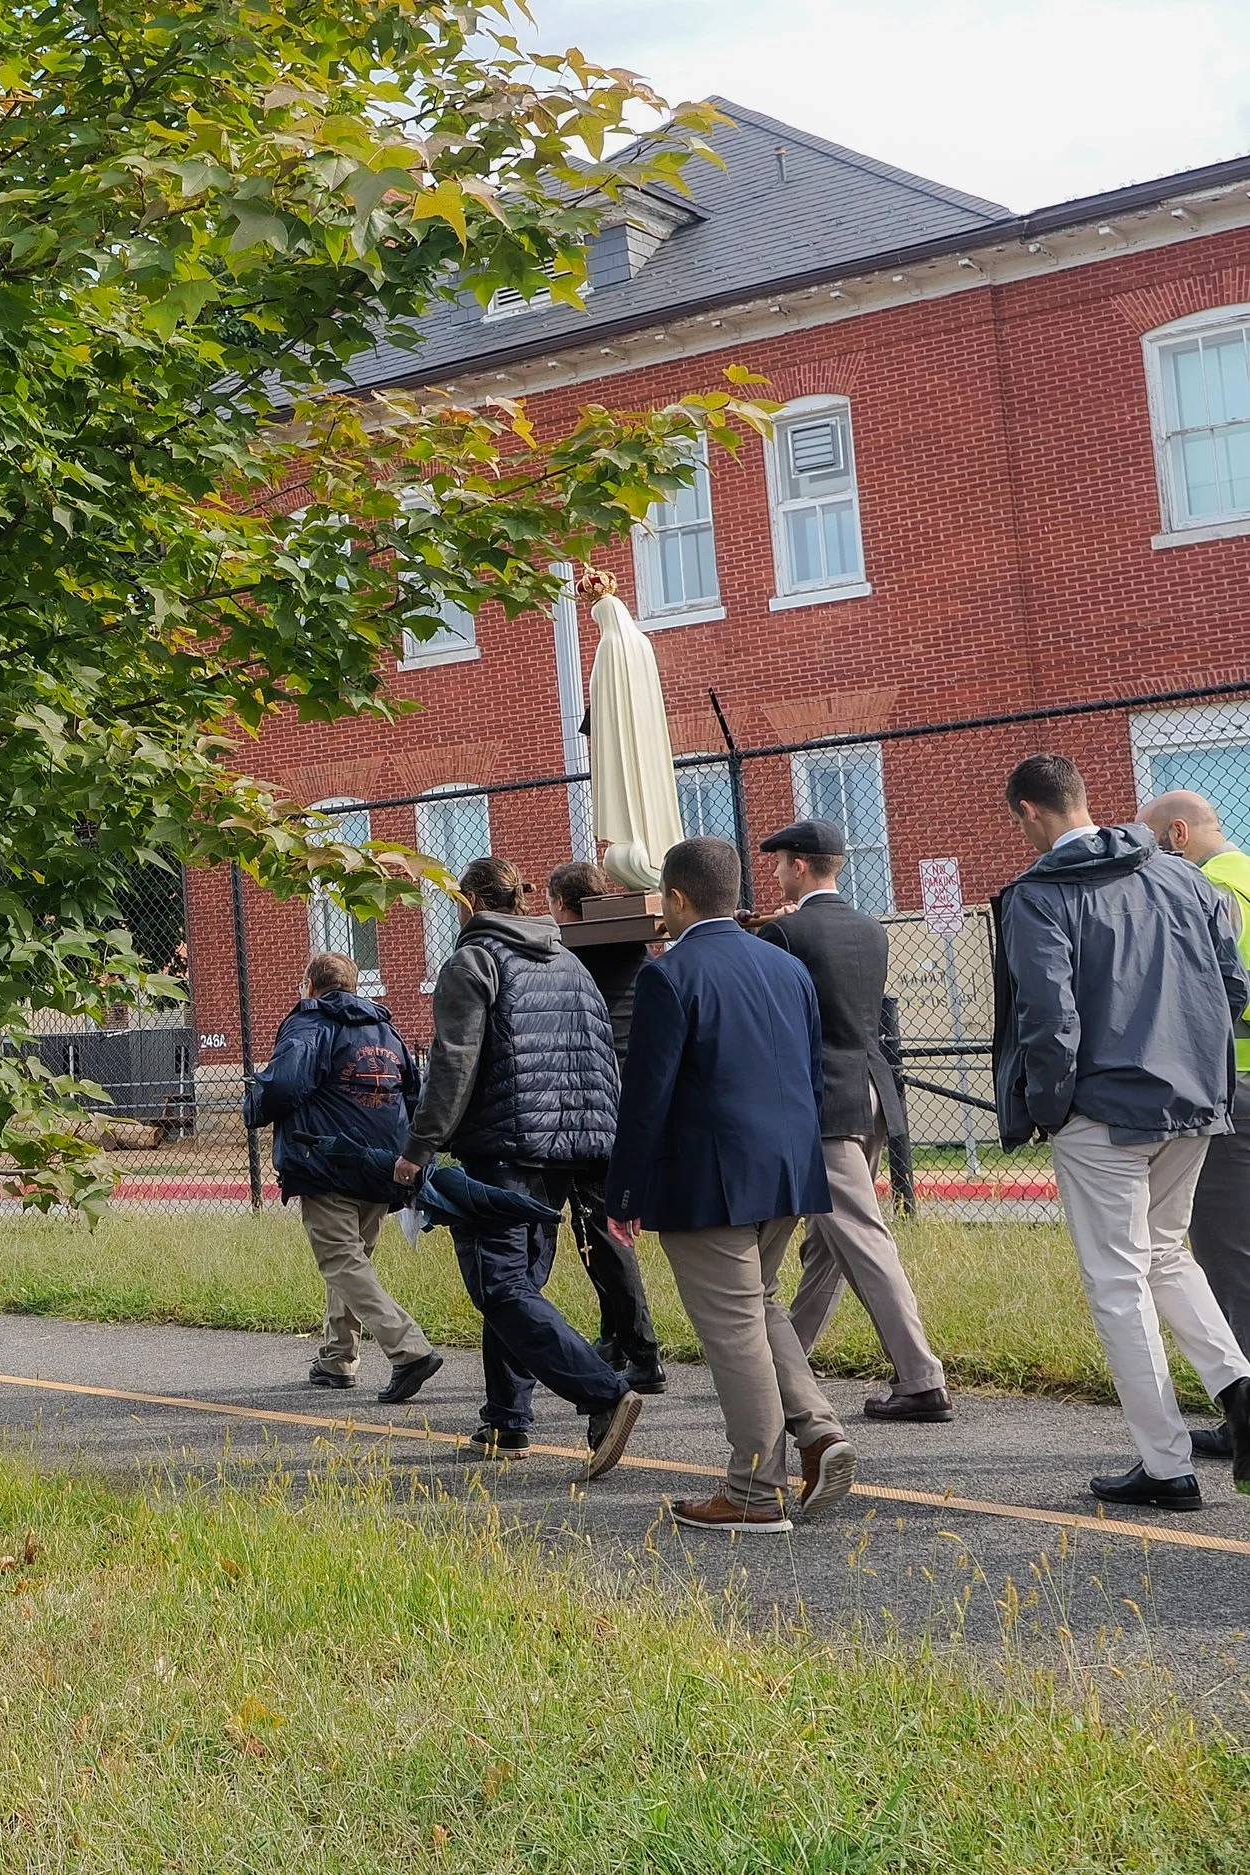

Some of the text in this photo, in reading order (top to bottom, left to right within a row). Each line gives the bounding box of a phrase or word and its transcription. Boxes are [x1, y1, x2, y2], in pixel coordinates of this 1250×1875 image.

[932, 864, 945, 875] NO
[924, 875, 957, 887] PARKING
[200, 1033, 227, 1048] 246A
